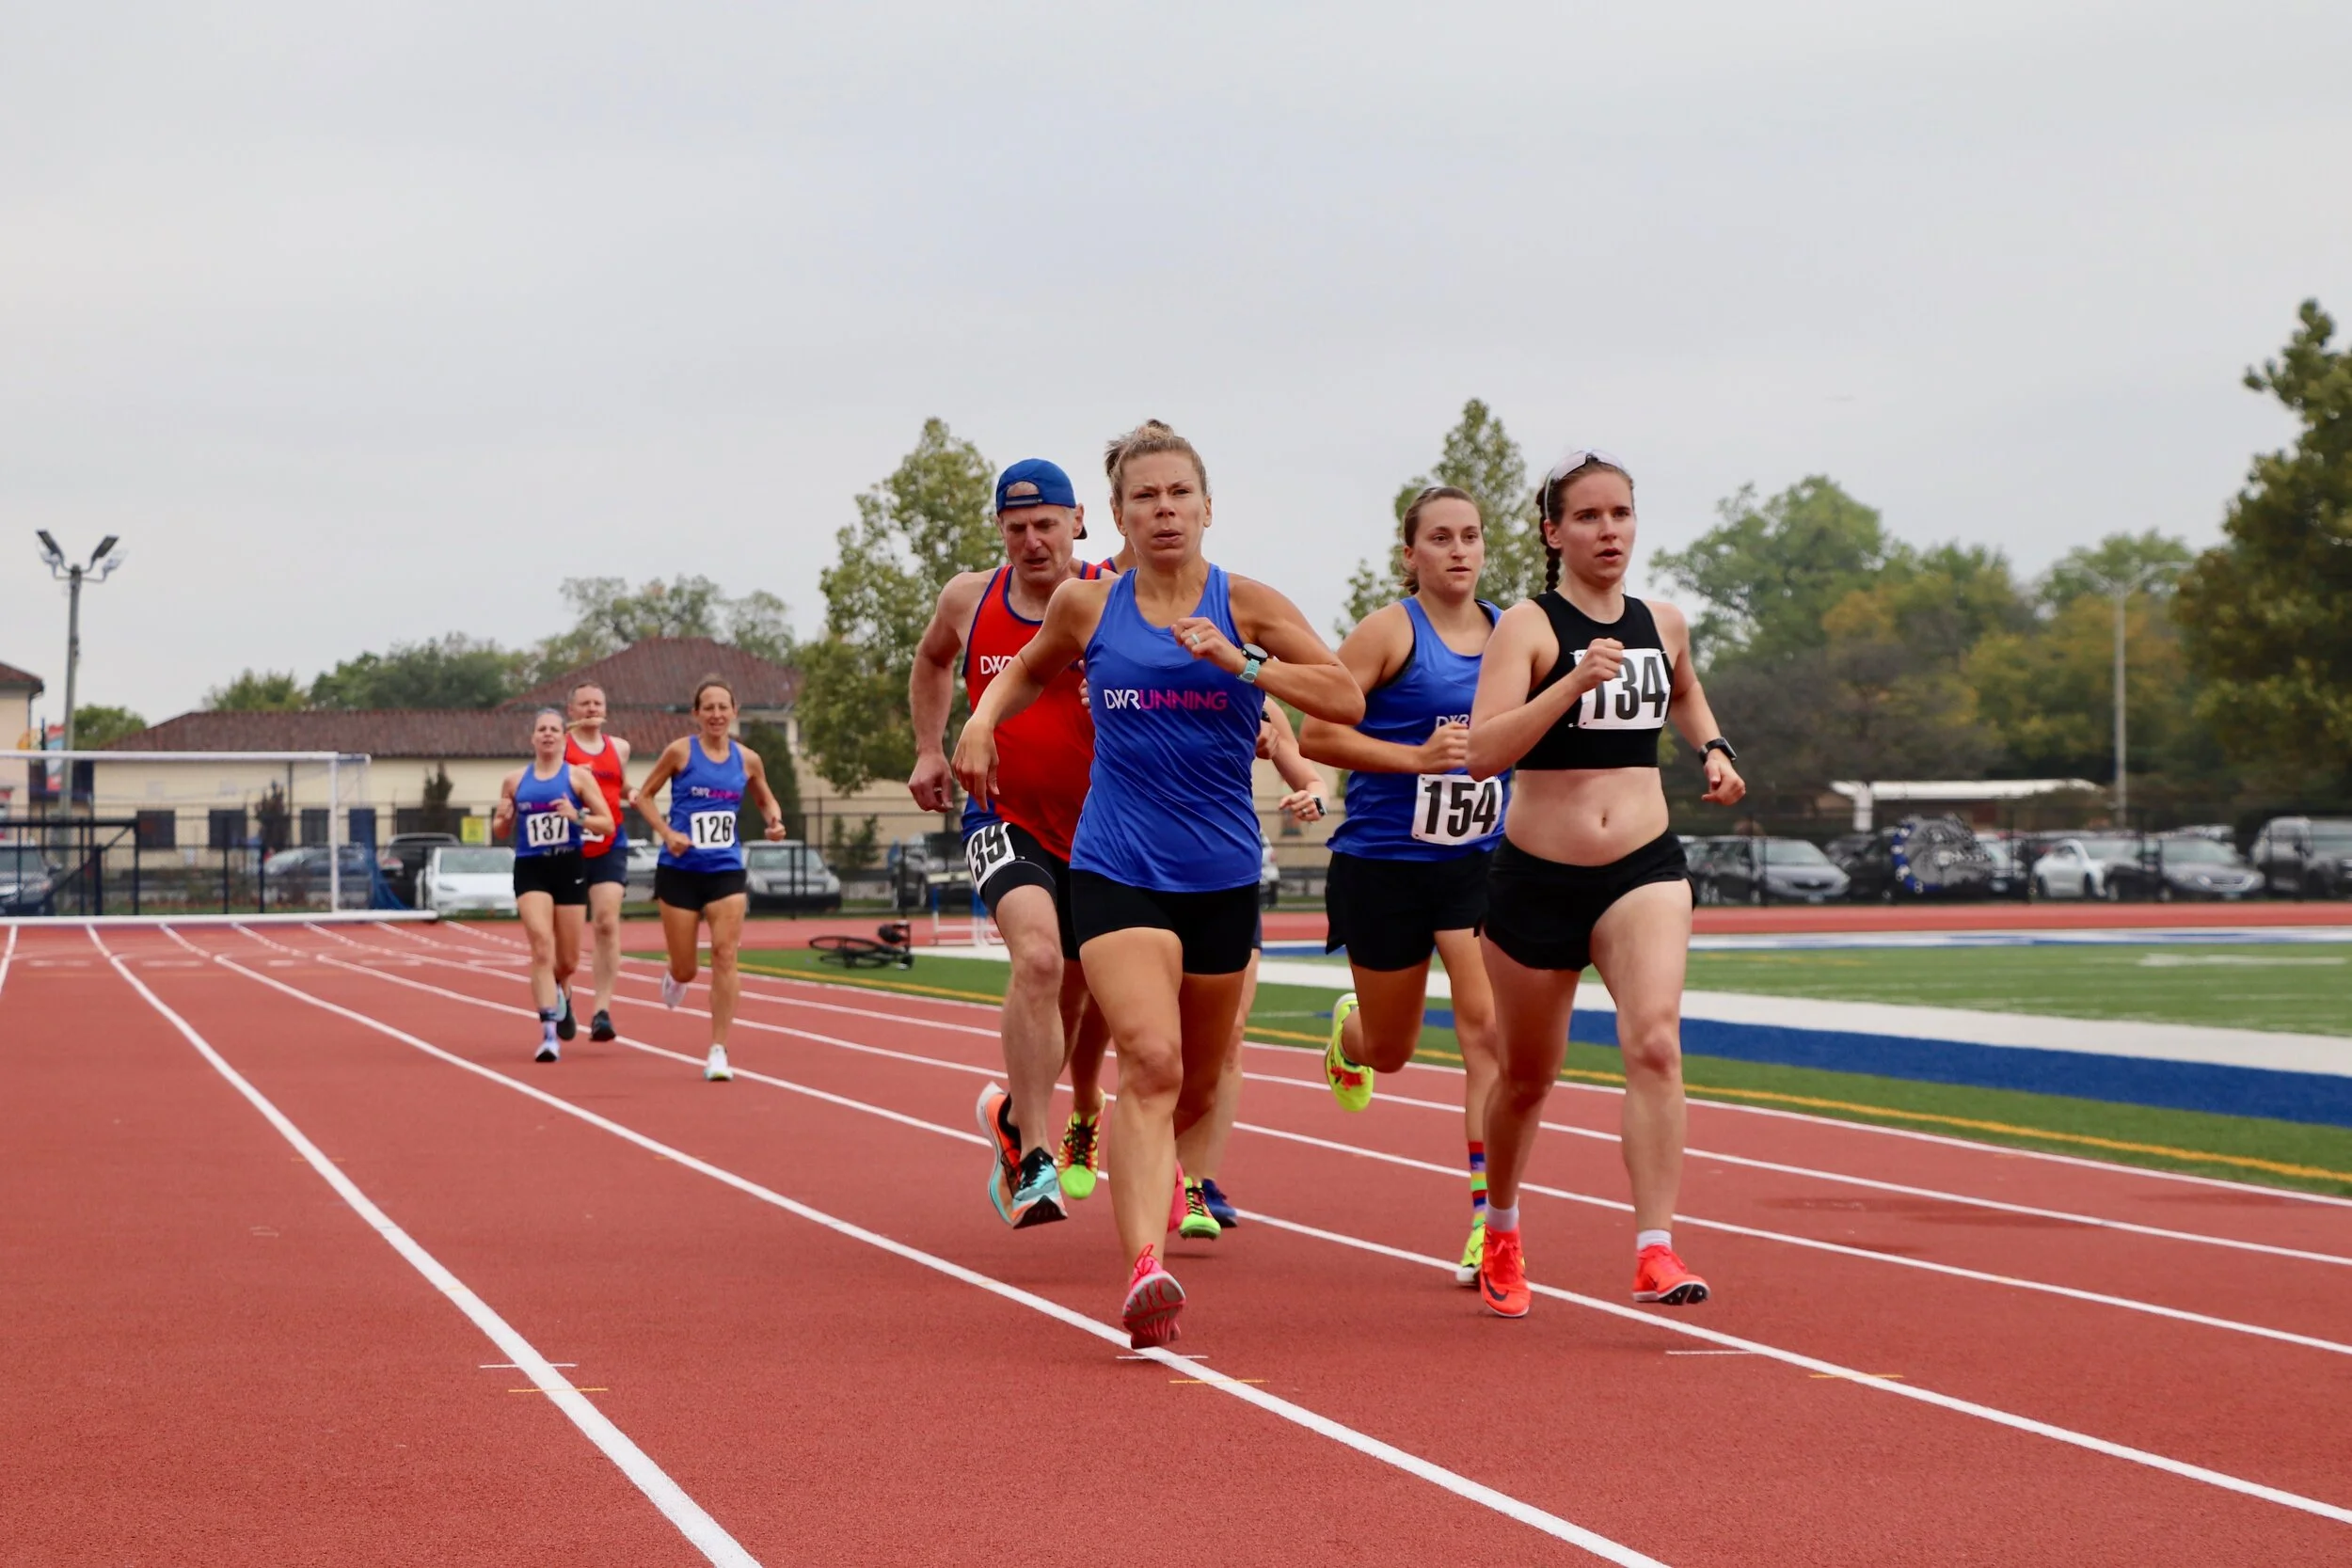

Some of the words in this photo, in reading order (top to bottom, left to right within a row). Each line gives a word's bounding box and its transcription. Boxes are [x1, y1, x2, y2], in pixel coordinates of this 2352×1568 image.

[1593, 656, 1666, 721] 134
[531, 815, 564, 842] 137
[696, 816, 733, 844] 126
[1424, 781, 1497, 837] 154
[967, 823, 1008, 883] 39
